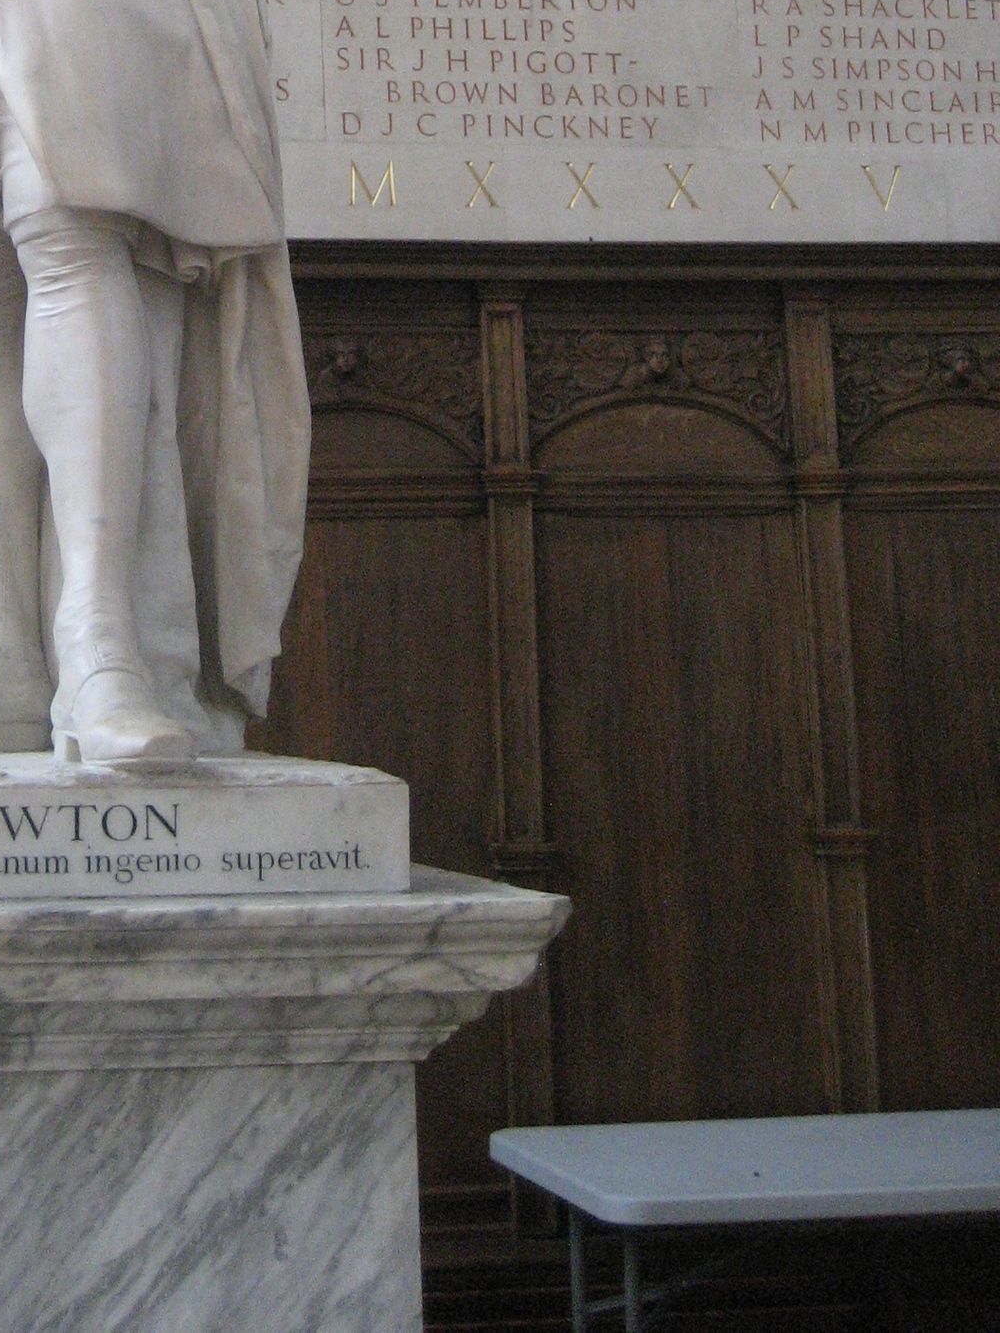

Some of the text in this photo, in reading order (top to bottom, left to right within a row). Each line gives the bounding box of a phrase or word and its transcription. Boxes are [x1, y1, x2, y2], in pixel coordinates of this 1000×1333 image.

[333, 14, 576, 44] A L PHILLIPS
[752, 23, 948, 52] L P SHAND
[84, 845, 201, 883] ingenio
[221, 842, 371, 881] superavit.
